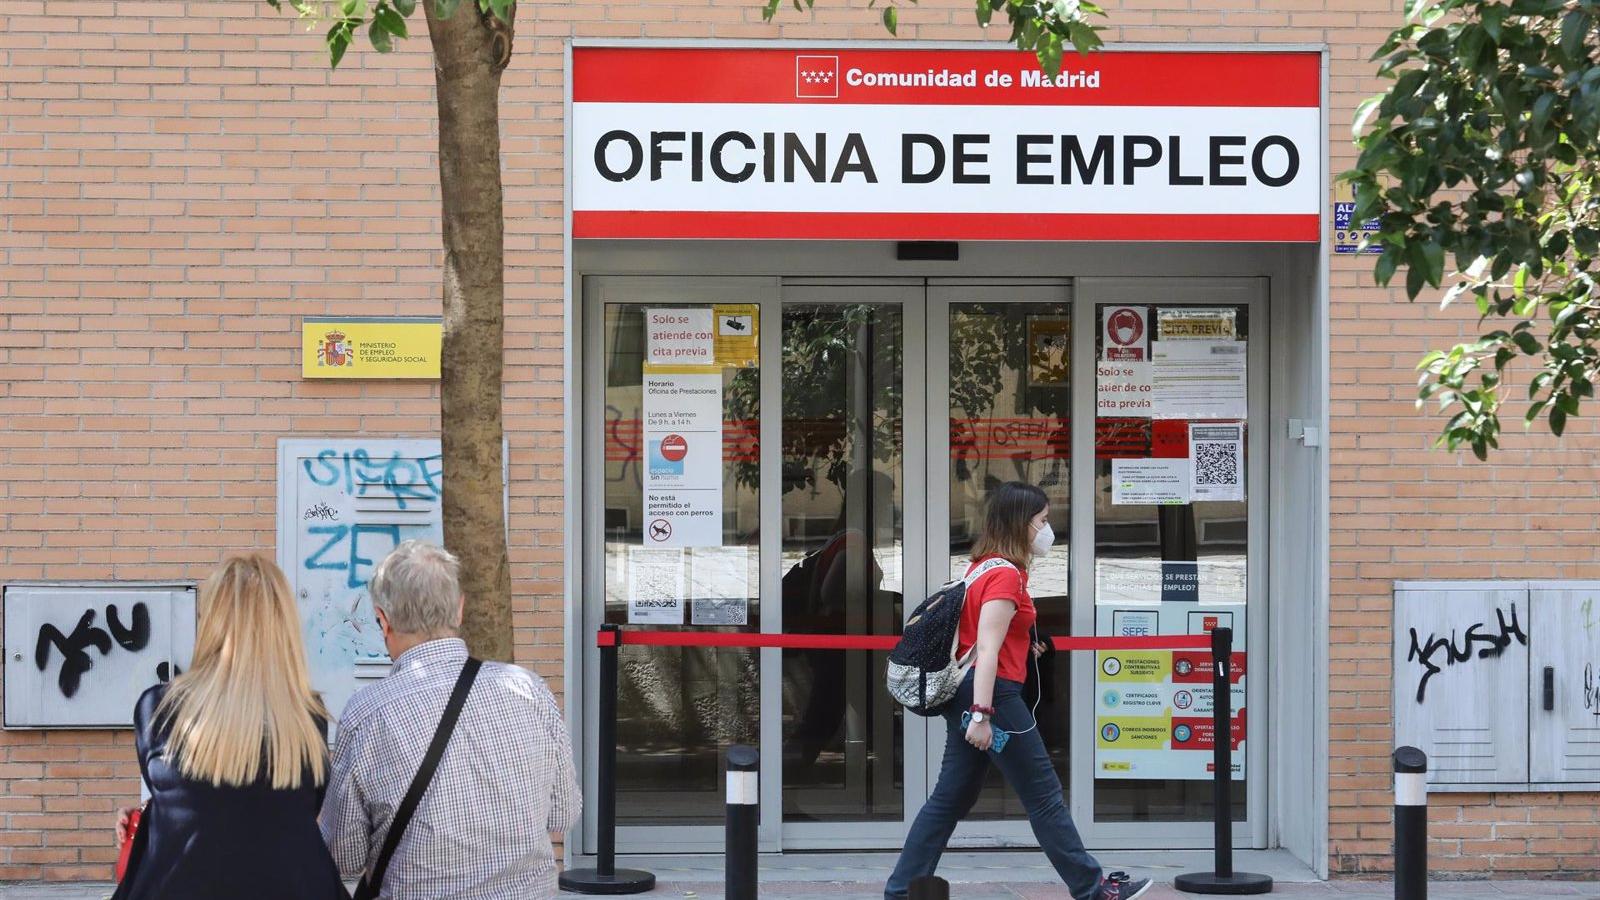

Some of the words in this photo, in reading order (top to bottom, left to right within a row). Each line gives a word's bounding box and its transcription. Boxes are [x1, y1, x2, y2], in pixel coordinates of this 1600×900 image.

[846, 68, 976, 88] Comunidad
[984, 70, 1012, 88] de
[1021, 70, 1100, 88] Madrid
[594, 129, 878, 183] OFICINA
[901, 133, 990, 184] DE
[1016, 135, 1300, 187] EMPLEO
[652, 314, 675, 324] Solo
[677, 316, 689, 324] se
[652, 331, 692, 340] atiende
[694, 332, 713, 340] con
[652, 347, 672, 356] cita
[674, 347, 707, 358] previa
[1123, 368, 1133, 376] se
[1098, 383, 1136, 392] atiende
[1098, 399, 1116, 408] cita
[1119, 399, 1151, 410] previa
[1122, 627, 1149, 637] SEPE
